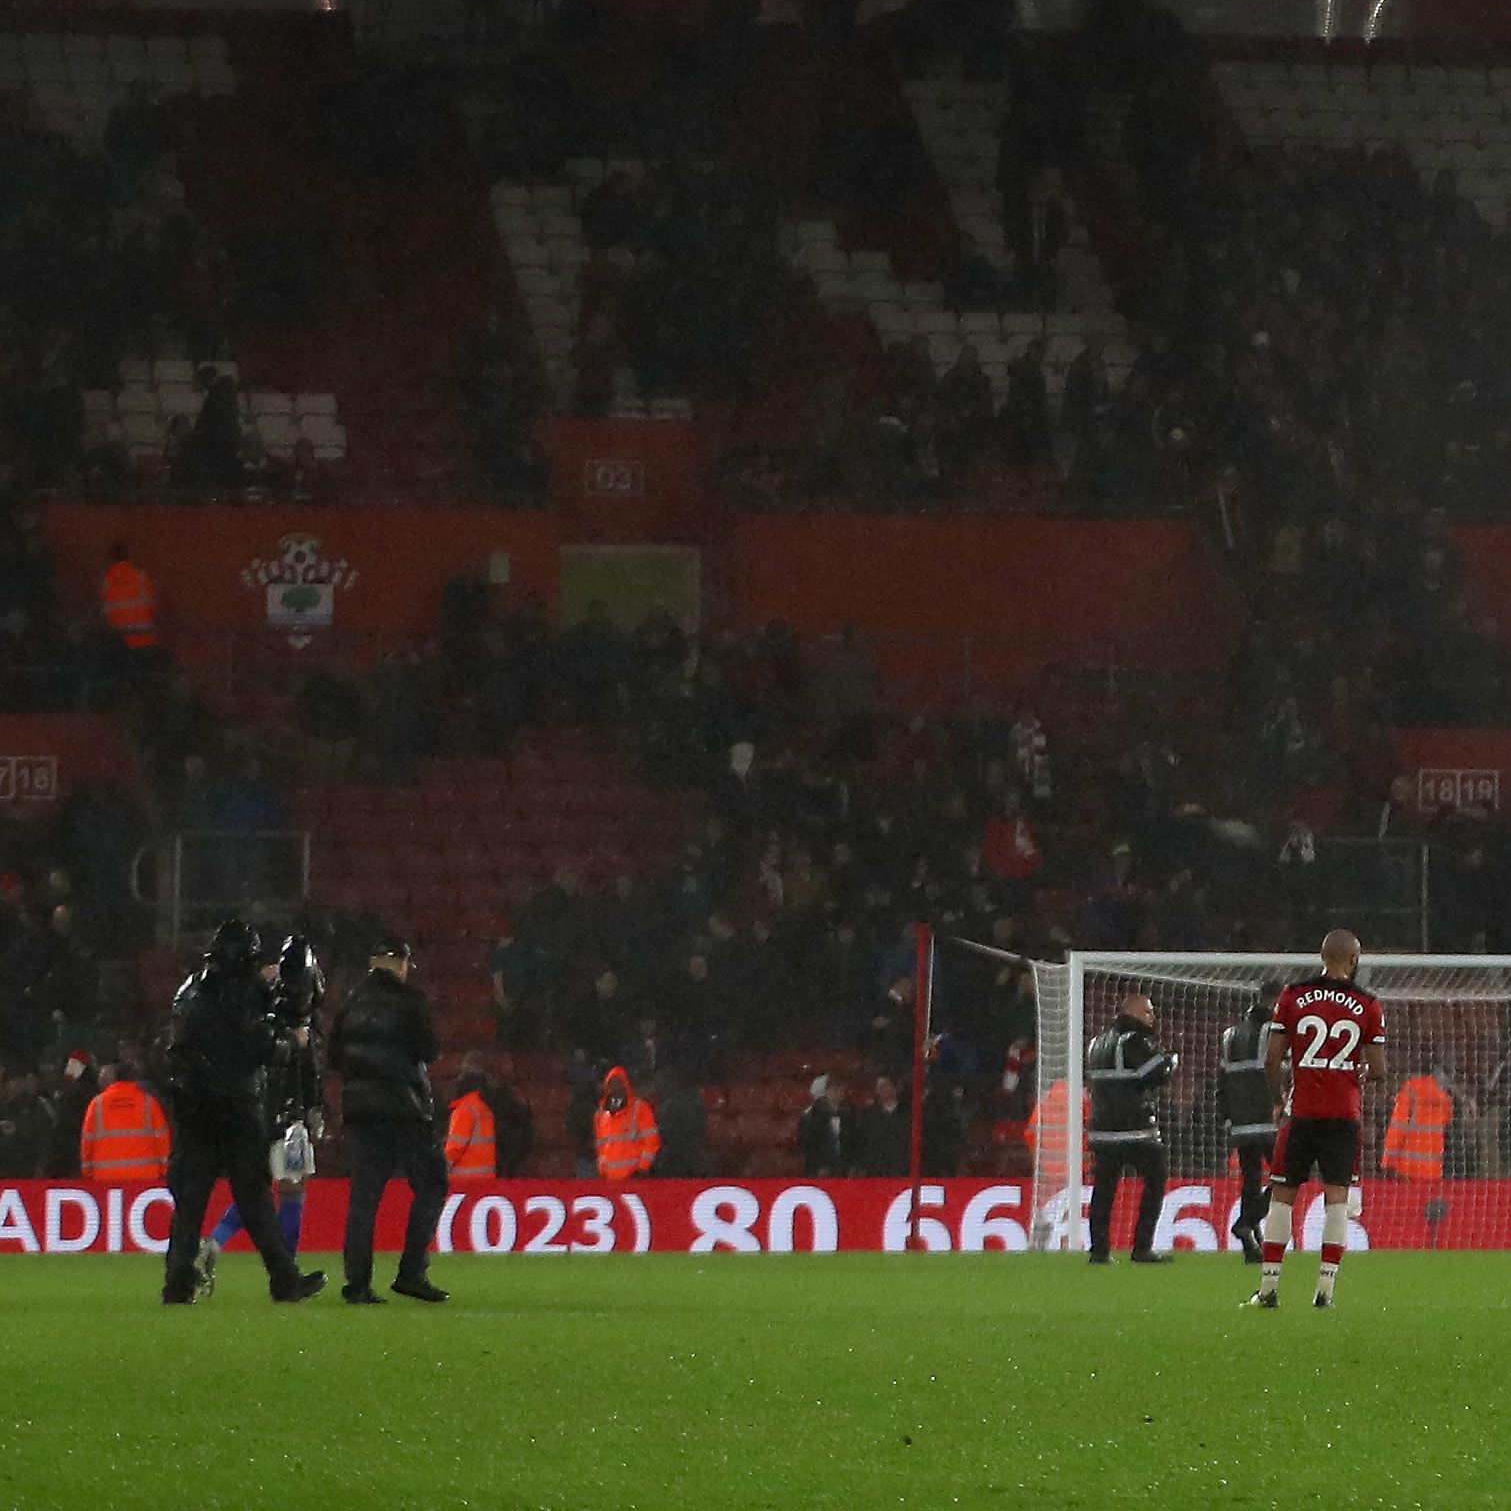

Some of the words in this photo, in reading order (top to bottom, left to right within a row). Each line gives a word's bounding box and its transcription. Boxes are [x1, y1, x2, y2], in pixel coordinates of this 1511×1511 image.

[1296, 989, 1364, 1016] REDMOND
[1296, 1015, 1361, 1071] 22
[436, 1193, 651, 1253] (023)
[689, 1185, 839, 1253] 80
